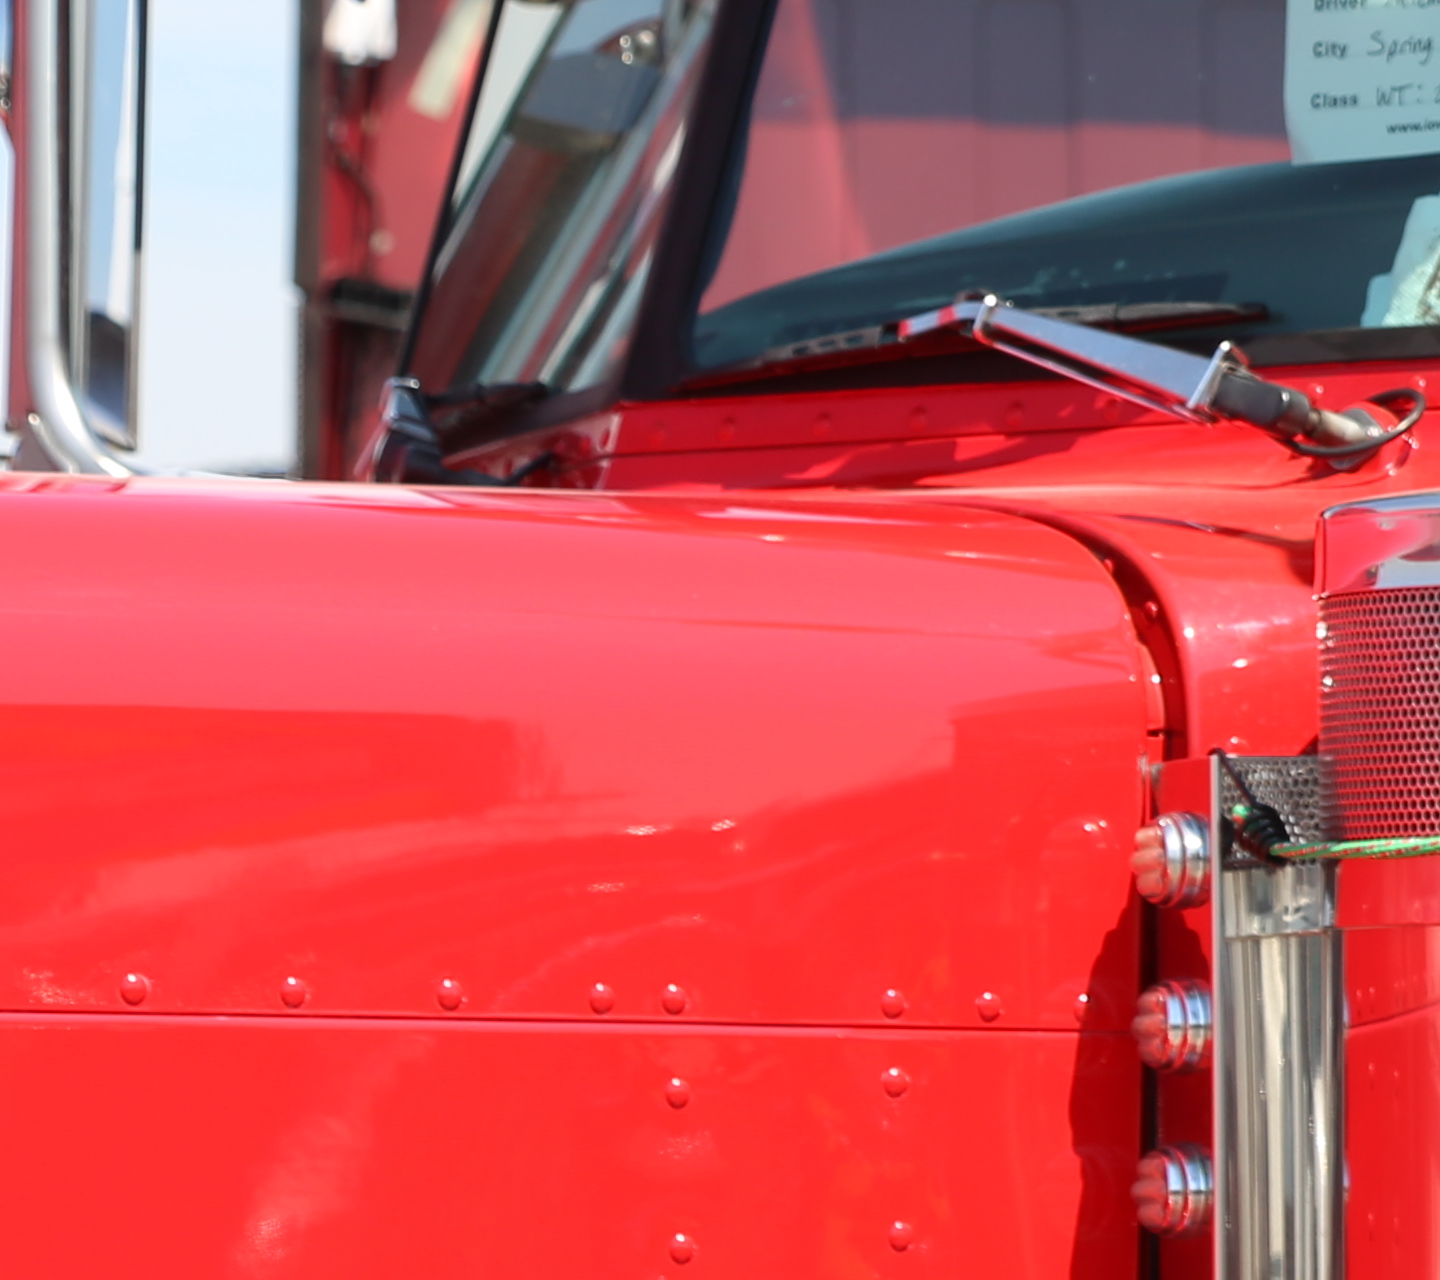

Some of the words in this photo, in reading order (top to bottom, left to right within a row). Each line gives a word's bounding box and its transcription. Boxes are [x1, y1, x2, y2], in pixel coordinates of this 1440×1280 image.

[1312, 41, 1348, 59] City
[1366, 29, 1433, 65] Spring
[1310, 92, 1358, 110] Class
